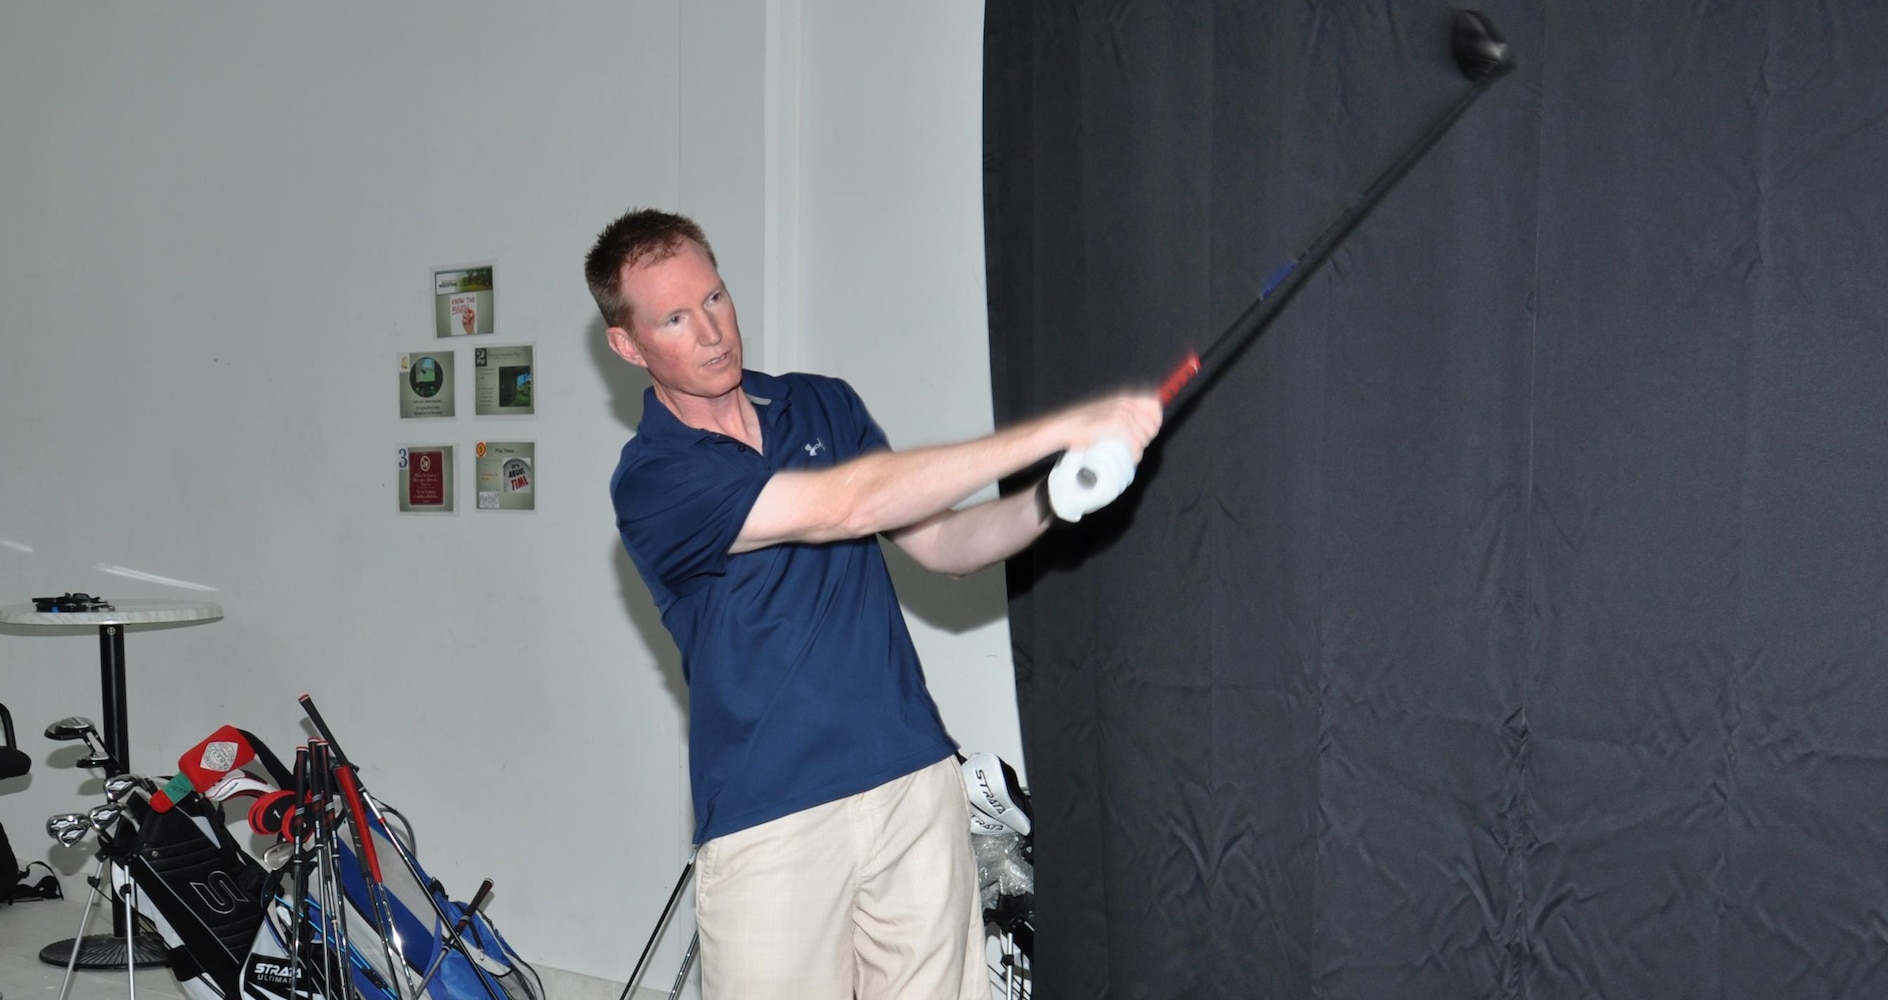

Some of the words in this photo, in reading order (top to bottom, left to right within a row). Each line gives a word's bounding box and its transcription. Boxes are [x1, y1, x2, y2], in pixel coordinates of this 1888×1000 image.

[398, 448, 408, 469] 3
[508, 467, 526, 479] ABOUT
[511, 475, 529, 491] TIME
[975, 769, 1006, 815] STRATA
[971, 812, 1004, 831] TRATA
[256, 973, 293, 984] ULTIMAT
